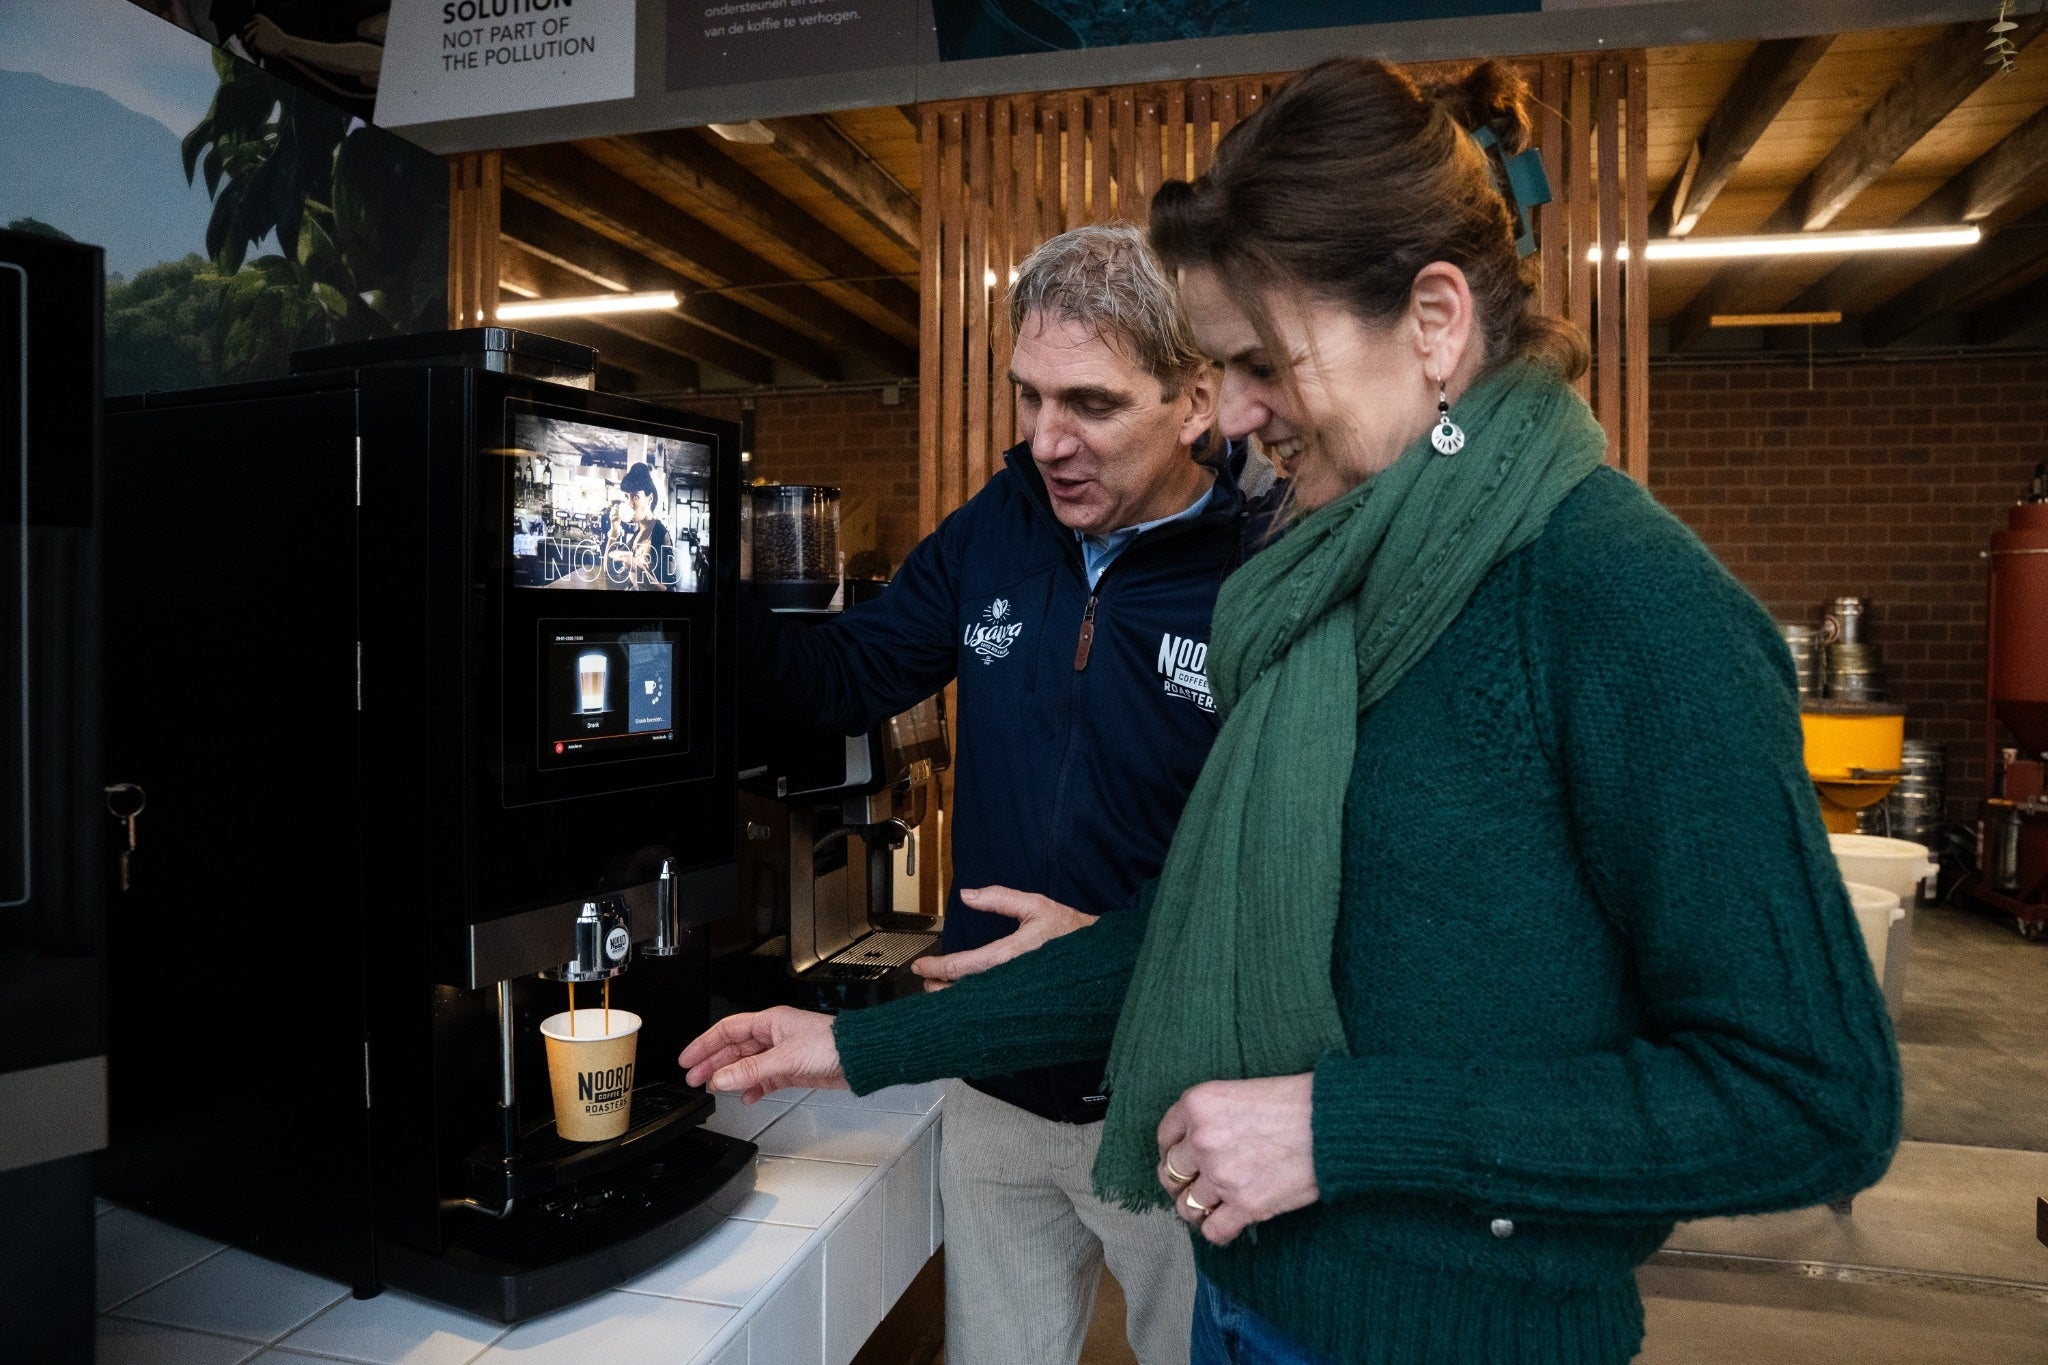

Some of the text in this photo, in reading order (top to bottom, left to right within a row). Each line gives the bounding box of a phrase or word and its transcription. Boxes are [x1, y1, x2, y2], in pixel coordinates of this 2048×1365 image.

[704, 0, 787, 17] ondersteunen
[443, 16, 569, 49] NOT PART OF
[704, 11, 860, 37] van de koffie te verhogen.
[442, 36, 595, 71] THE POLLUTION
[544, 537, 682, 585] NOORD
[1157, 632, 1208, 677] NOO
[1164, 680, 1217, 709] ROASTER
[1178, 673, 1208, 688] COFFEE
[578, 1063, 632, 1101] NOORD
[598, 1091, 621, 1100] COFFEE
[585, 1098, 627, 1113] ROASTERS
